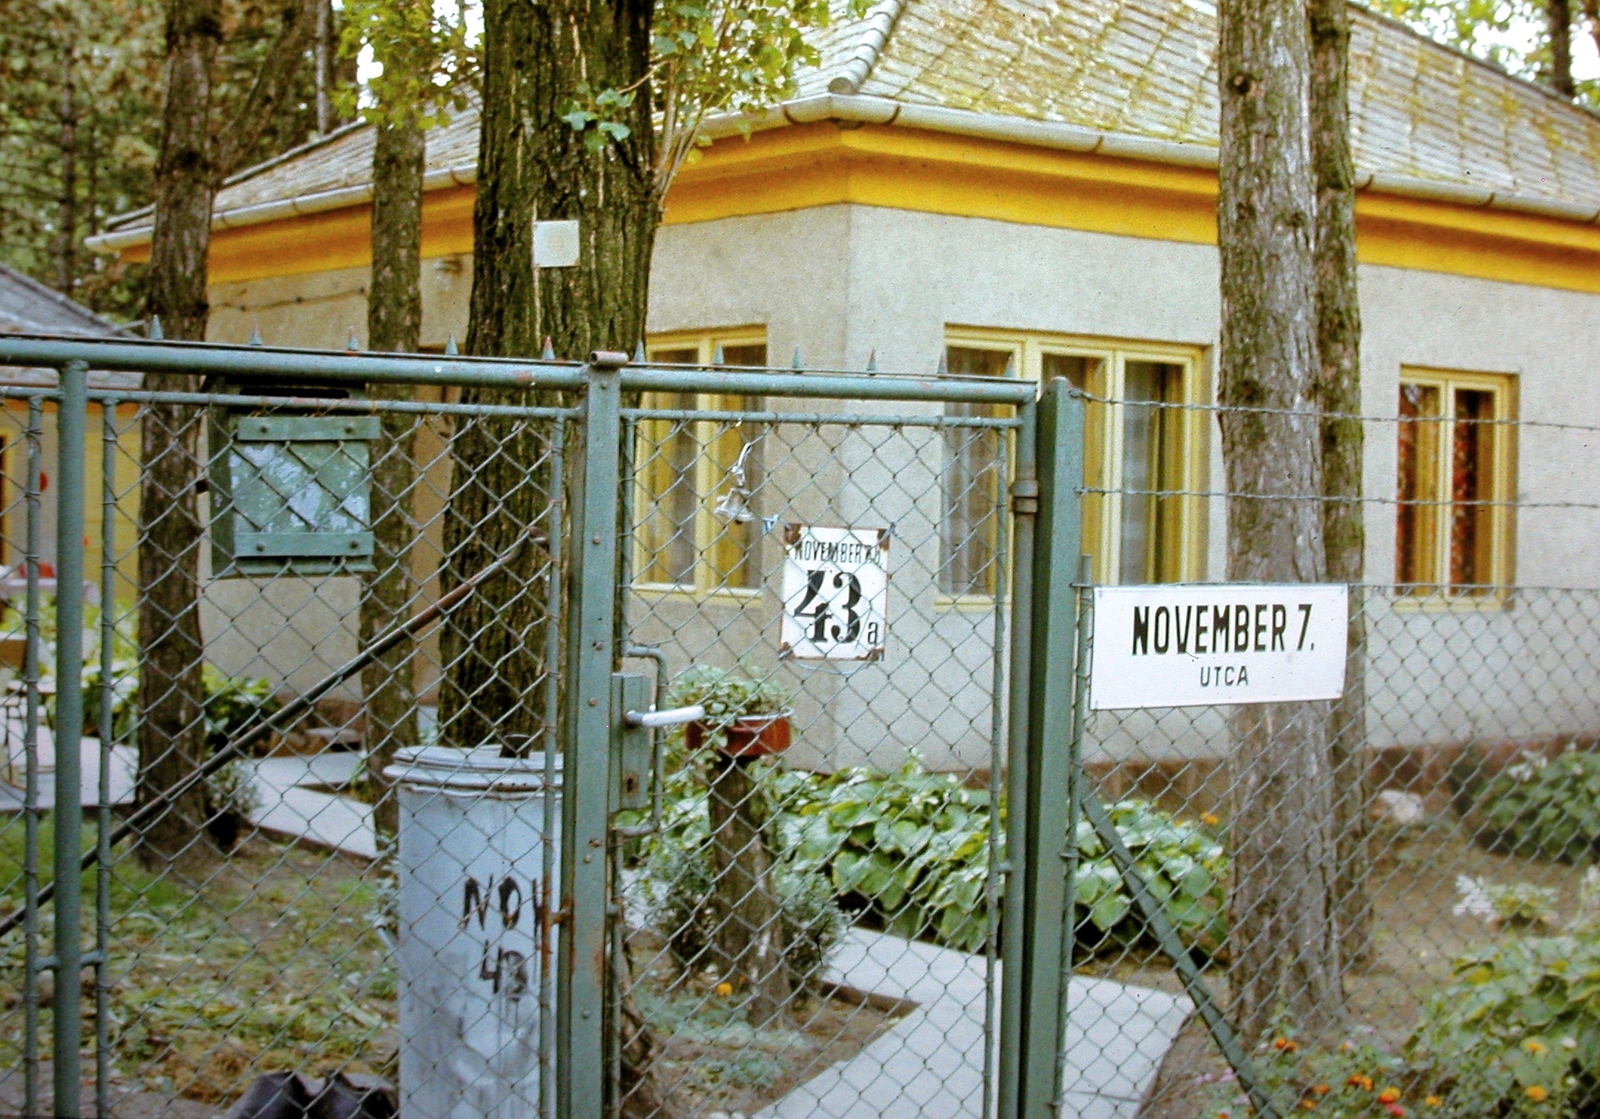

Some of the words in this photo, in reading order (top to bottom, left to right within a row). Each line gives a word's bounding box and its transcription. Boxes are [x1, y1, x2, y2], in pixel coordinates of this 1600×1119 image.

[794, 540, 862, 563] NOVEMBER
[1132, 603, 1287, 656] NOVEMBER
[1296, 603, 1315, 652] 7.
[1200, 665, 1249, 687] UTCA
